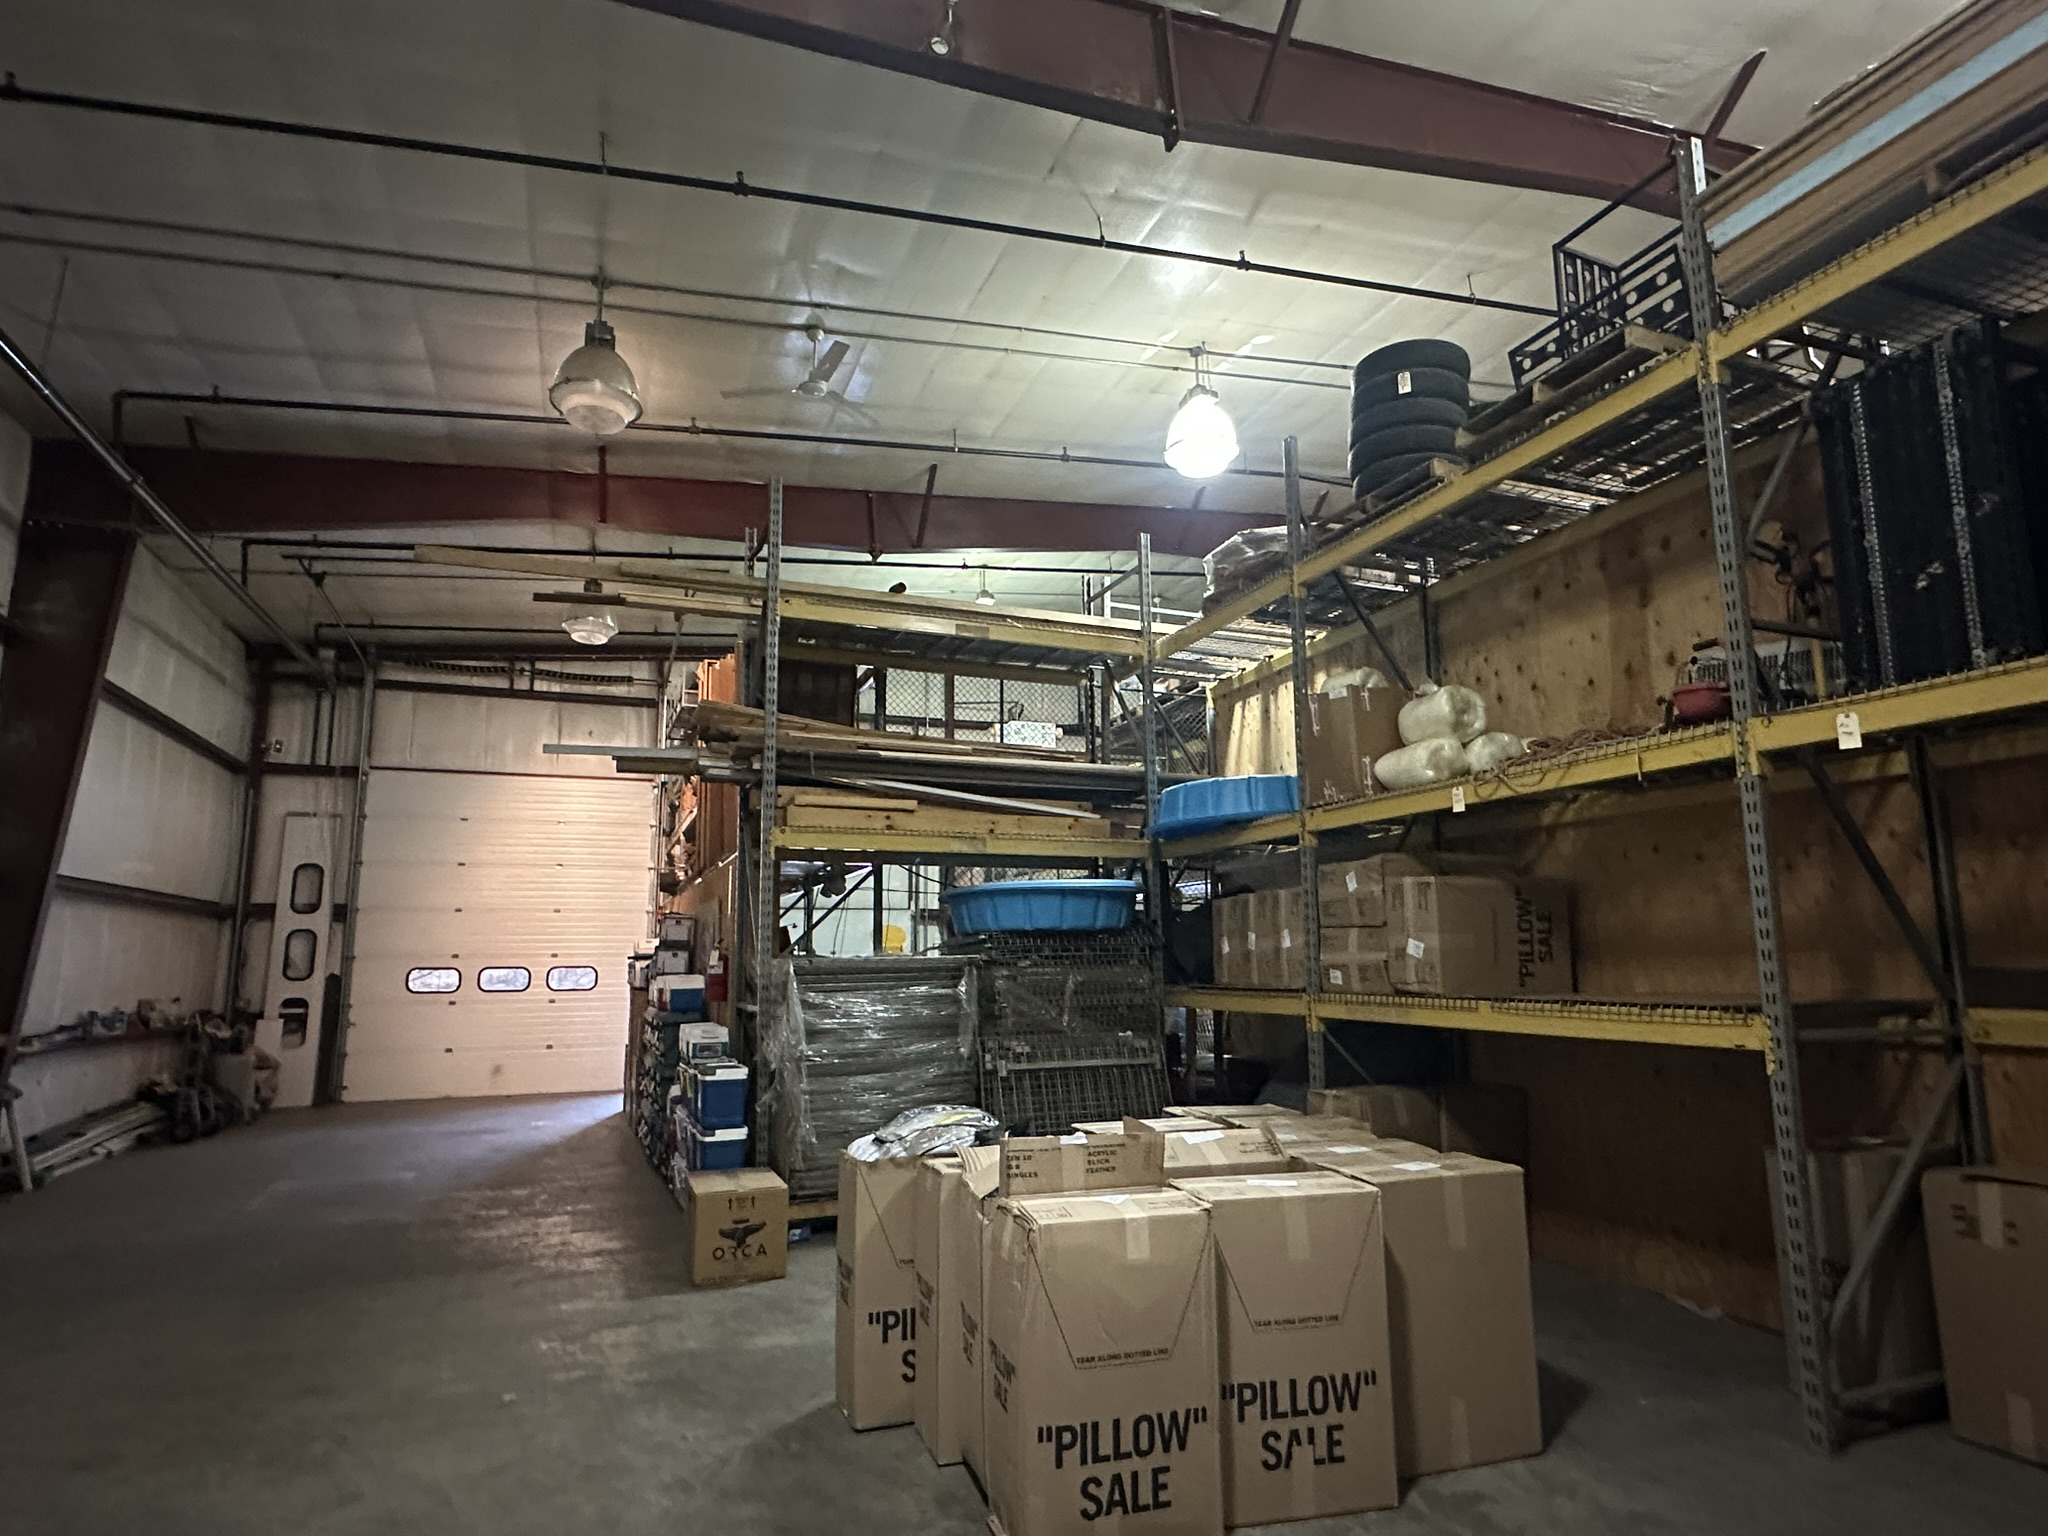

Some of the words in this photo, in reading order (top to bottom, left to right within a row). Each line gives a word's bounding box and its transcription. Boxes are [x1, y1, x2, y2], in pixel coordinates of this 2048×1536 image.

[1536, 909, 1553, 964] SALE
[712, 1243, 768, 1261] ORCA
[1076, 1355, 1096, 1364] TEAR
[1097, 1352, 1122, 1362] ALONG
[1123, 1349, 1152, 1359] DOTTED
[1153, 1347, 1169, 1356] LINE
[1221, 1369, 1377, 1423] "PILLOW"
[1037, 1405, 1208, 1470] "PILLOW"
[1079, 1465, 1173, 1522] SALE
